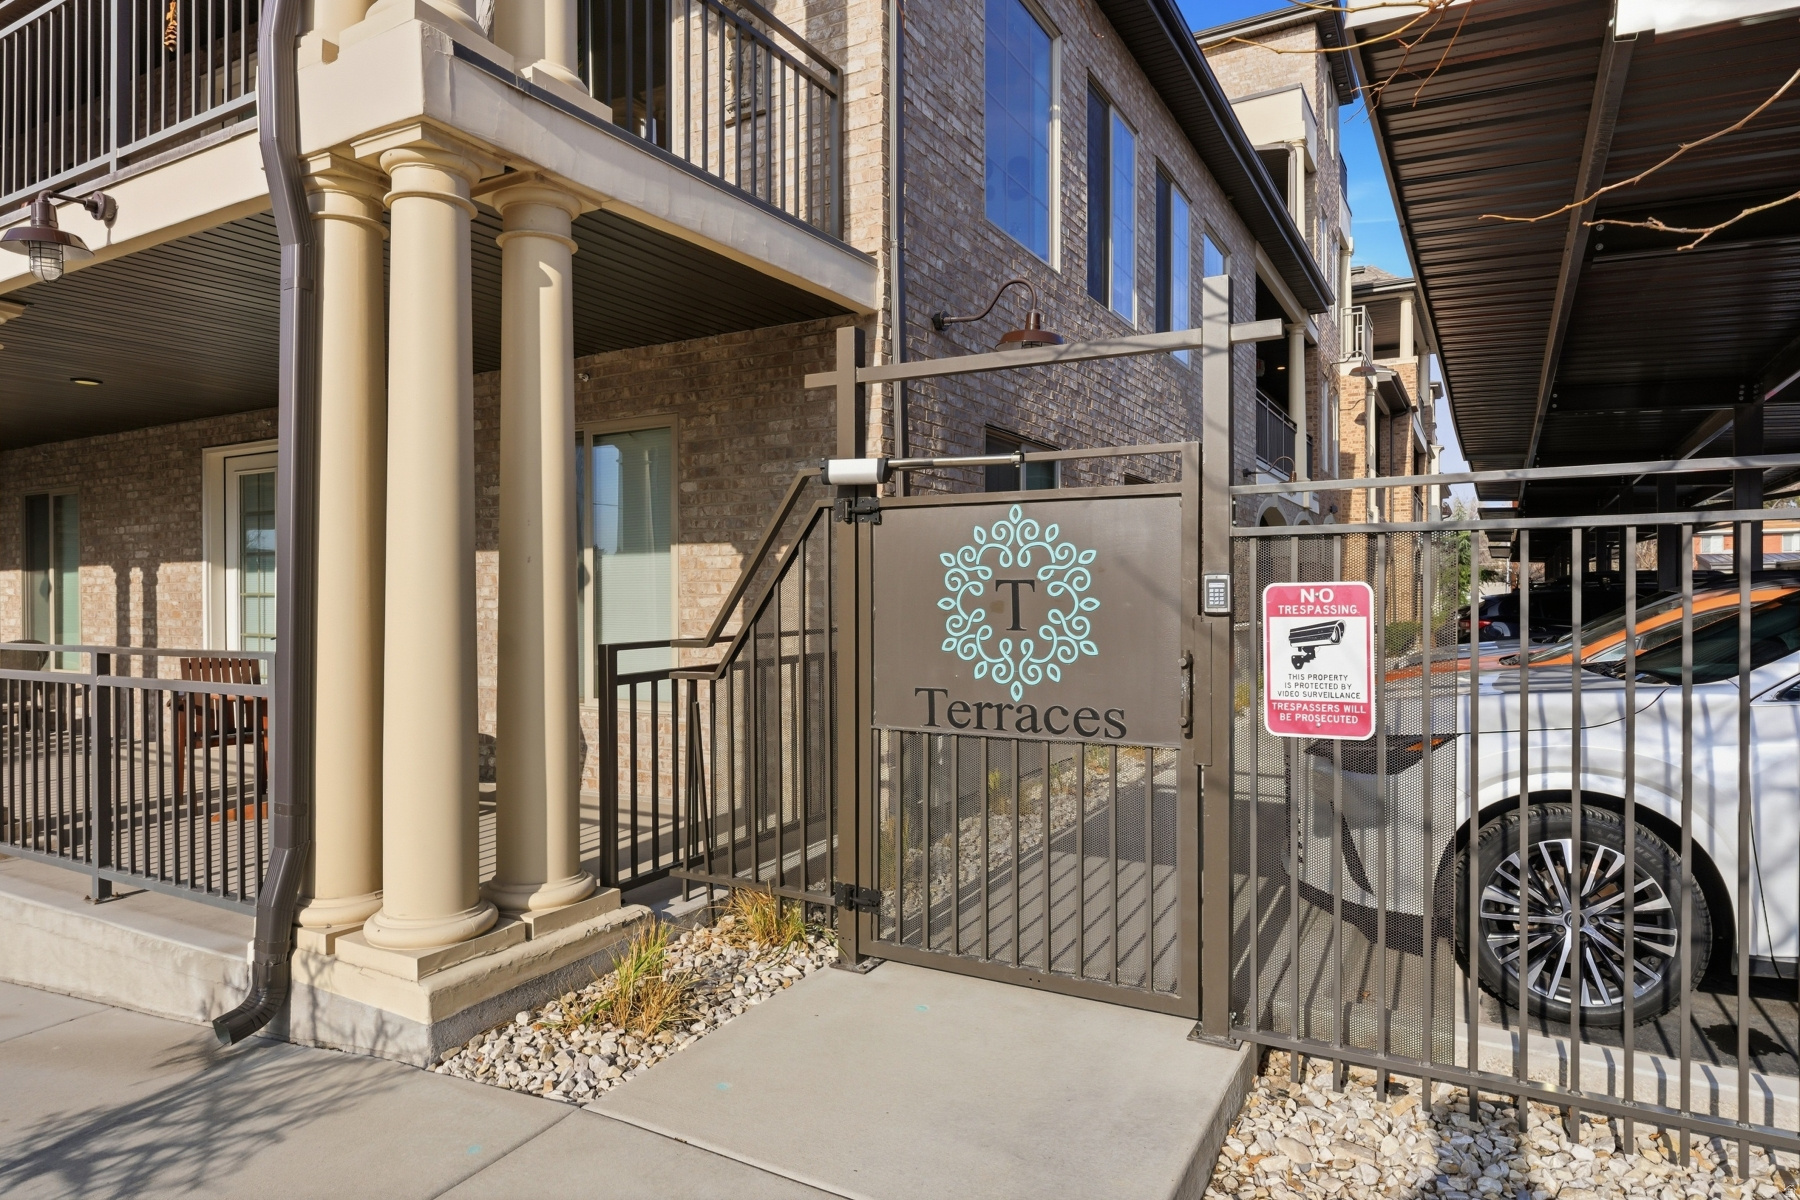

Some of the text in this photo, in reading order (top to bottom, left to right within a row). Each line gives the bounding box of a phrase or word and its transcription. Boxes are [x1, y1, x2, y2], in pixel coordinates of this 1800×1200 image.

[1300, 588, 1334, 603] NO
[995, 579, 1035, 631] T
[1278, 604, 1358, 615] TRESPASSING
[1288, 673, 1348, 681] THIS PROPERTY
[1294, 682, 1338, 690] PROTECTED
[1277, 690, 1361, 699] VIDEO SURVEILLANCE
[914, 687, 1127, 739] Terraces
[1272, 702, 1366, 714] TRESPASSERS WILL
[1280, 713, 1359, 724] BE PROSECUTED
